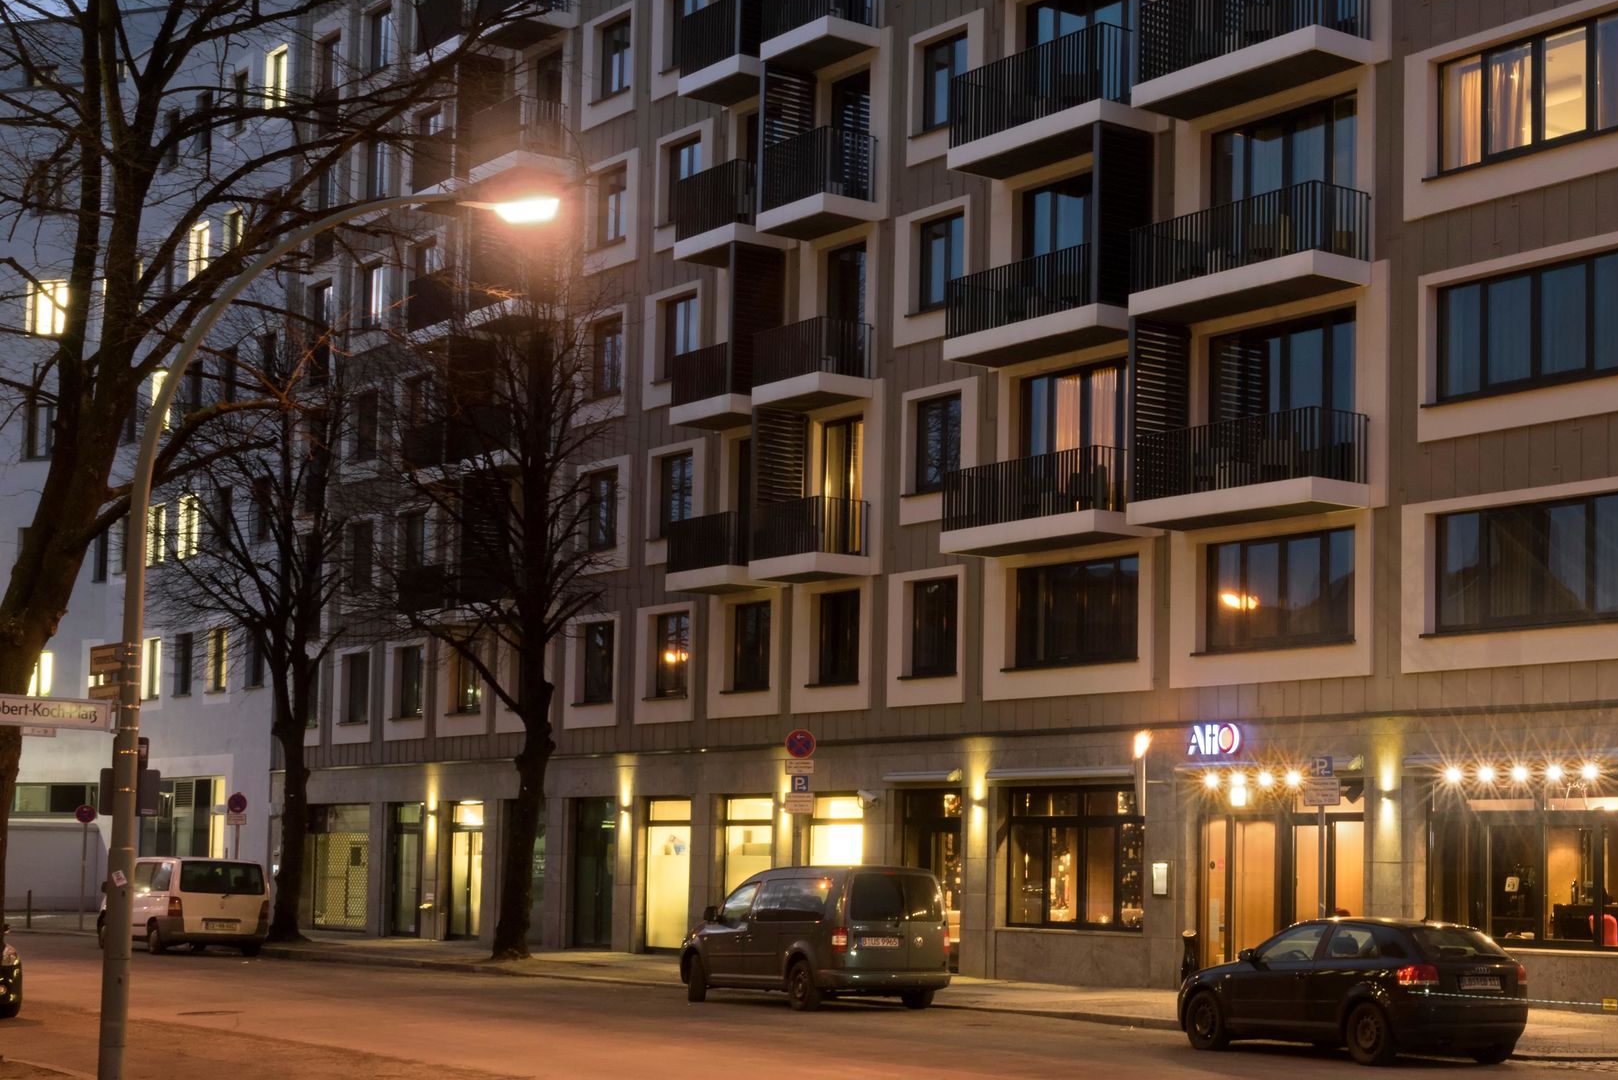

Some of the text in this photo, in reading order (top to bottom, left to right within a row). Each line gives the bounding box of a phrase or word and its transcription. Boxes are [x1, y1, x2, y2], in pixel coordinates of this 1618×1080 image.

[0, 701, 98, 723] bert-Koch-Platz
[1316, 758, 1328, 775] P
[794, 777, 805, 791] P
